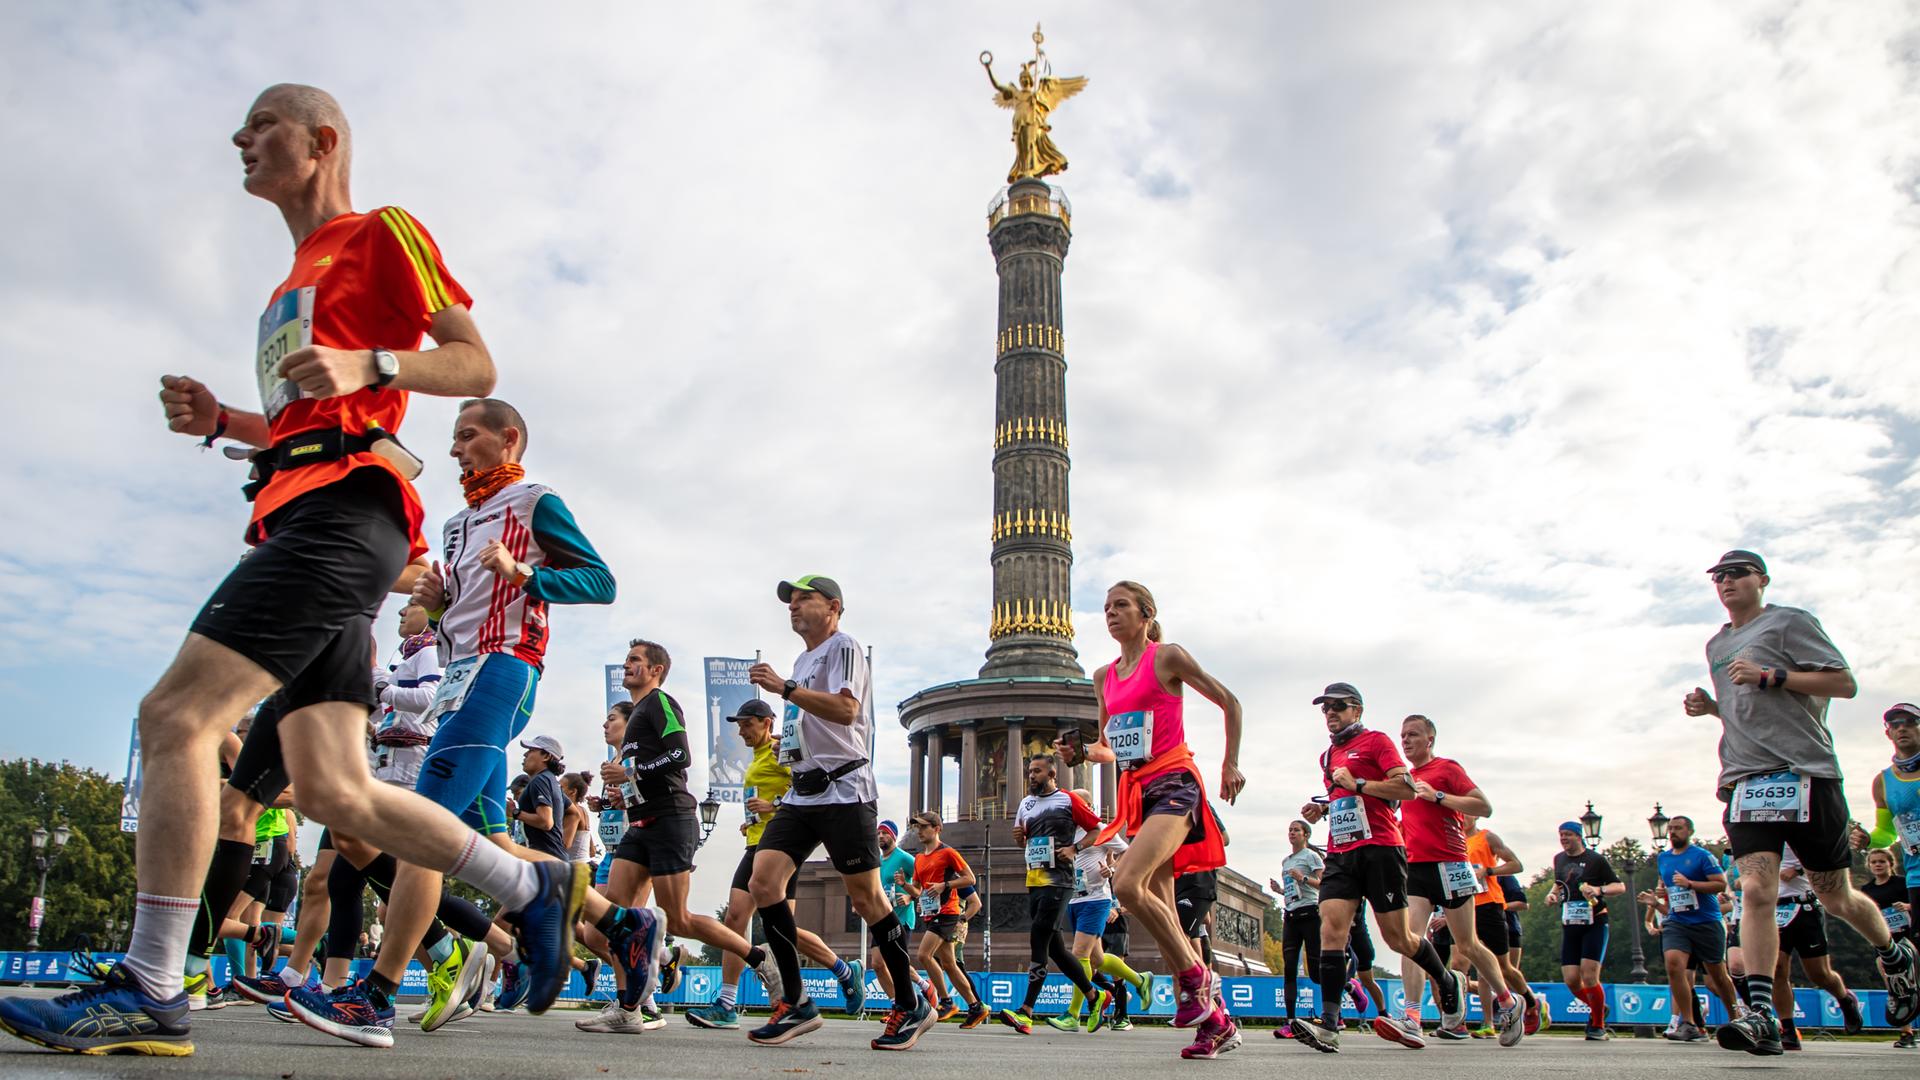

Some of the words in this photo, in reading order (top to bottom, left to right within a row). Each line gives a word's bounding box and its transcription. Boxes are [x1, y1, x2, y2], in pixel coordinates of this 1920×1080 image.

[1109, 732, 1139, 748] 71208
[1745, 786, 1796, 799] 56639
[1763, 800, 1775, 808] Jet
[1887, 914, 1903, 923] 3153
[802, 979, 824, 987] BMW
[1042, 985, 1059, 993] MW
[865, 992, 889, 1000] didas
[1566, 1005, 1592, 1013] adida
